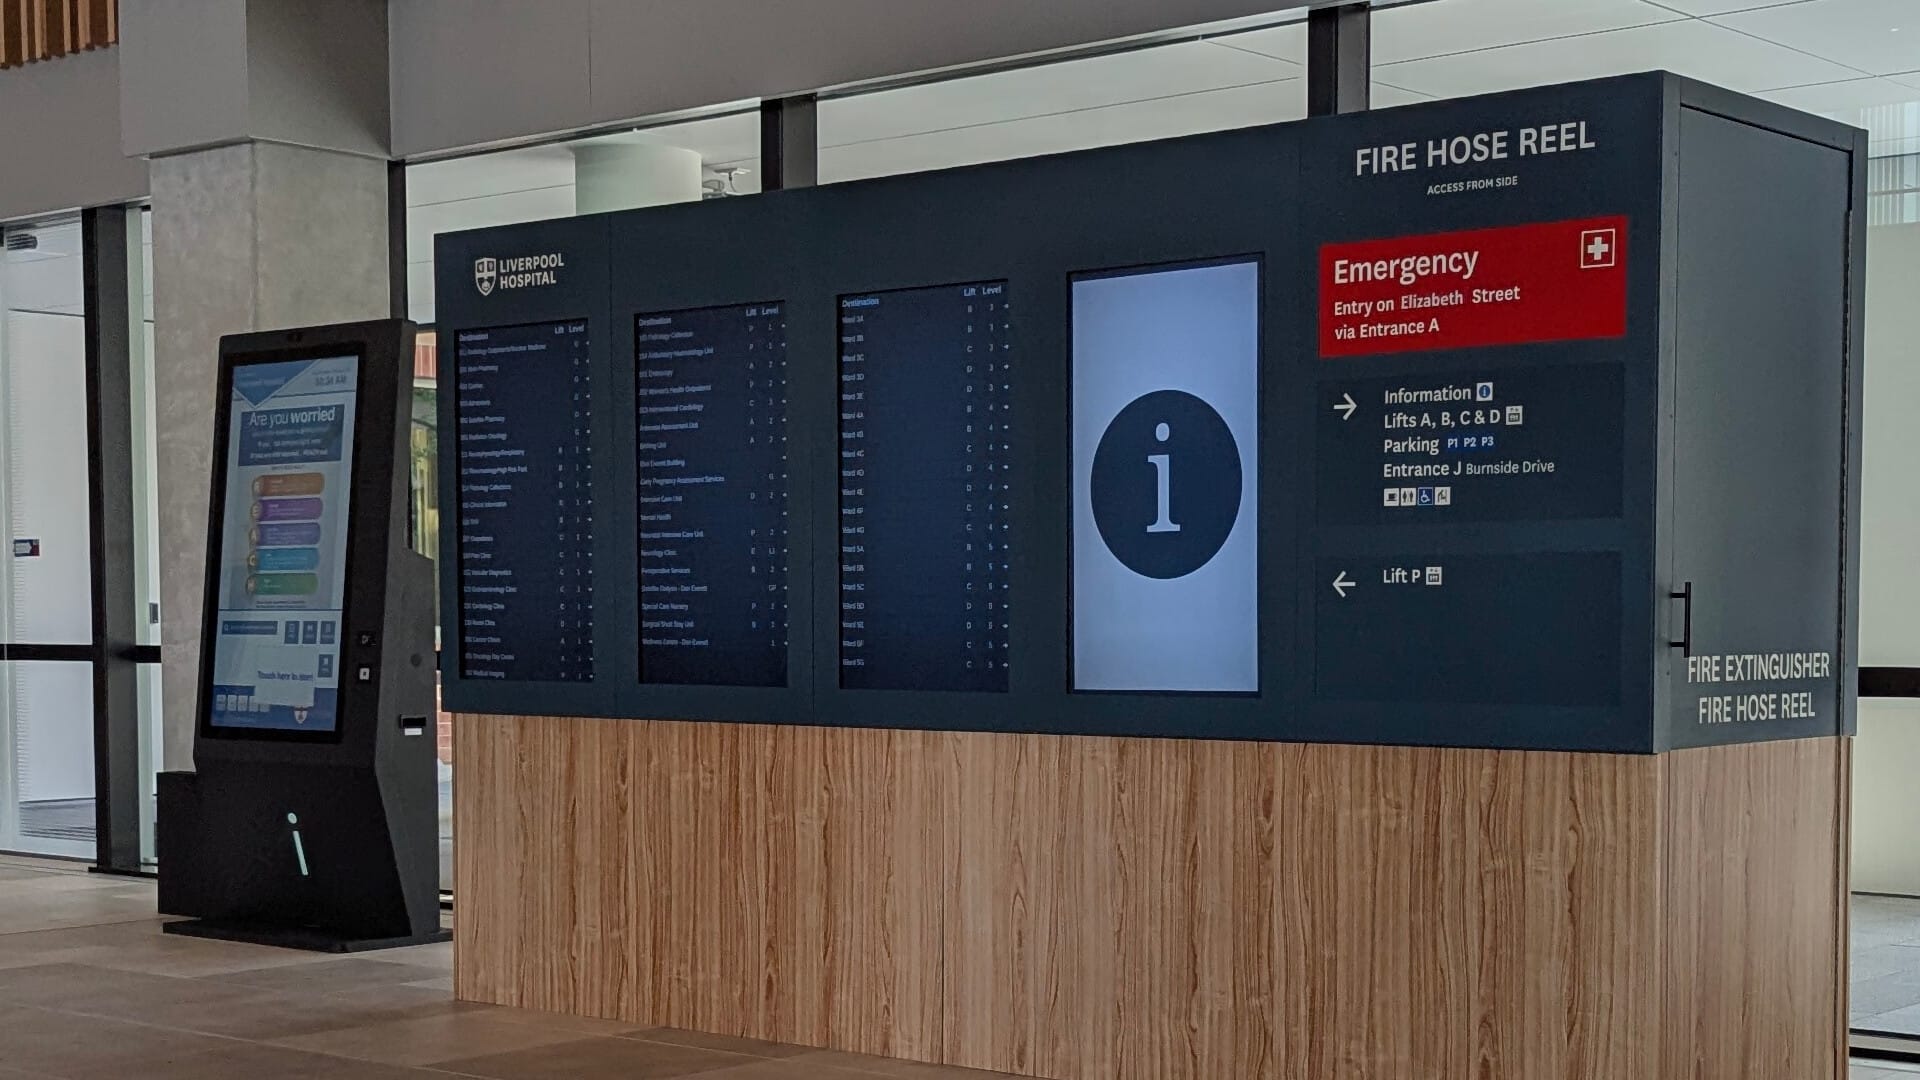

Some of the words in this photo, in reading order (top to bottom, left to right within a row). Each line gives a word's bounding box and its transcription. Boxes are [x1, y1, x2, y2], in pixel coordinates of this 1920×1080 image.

[1355, 143, 1416, 177] FIRE
[1427, 131, 1508, 168] HOSE
[1518, 120, 1596, 157] REEL
[1426, 182, 1464, 196] ACCESS
[1466, 179, 1493, 191] FROM
[1495, 175, 1518, 188] SIDE
[499, 253, 564, 273] LIVERPOOL
[1334, 250, 1479, 286] Emergency
[499, 270, 557, 289] HOSPITAL
[1334, 300, 1373, 317] Entry
[1376, 301, 1394, 313] on
[1400, 291, 1463, 310] Elizabeth
[1471, 285, 1520, 304] Street
[1334, 322, 1355, 340] via
[1359, 320, 1424, 338] Entrance
[1427, 318, 1439, 332] A
[1384, 386, 1471, 405] Information
[249, 411, 268, 427] Are
[269, 413, 288, 428] you
[290, 406, 336, 425] worried
[1383, 413, 1416, 429] Lifts
[1420, 413, 1436, 429] A,
[1441, 412, 1455, 428] B,
[1459, 411, 1470, 426] C
[1473, 410, 1485, 425] &
[1489, 409, 1500, 424] D
[1383, 436, 1439, 455] Parking
[1447, 438, 1458, 450] P1
[1463, 437, 1477, 449] P2
[1481, 436, 1494, 448] P3
[1383, 462, 1450, 478] Entrance
[1453, 461, 1461, 476] J
[1465, 461, 1519, 476] Burnside
[1521, 459, 1555, 474] Drive
[1383, 569, 1408, 584] Lift
[1411, 569, 1420, 584] P
[1687, 655, 1721, 683] FIRE
[1725, 652, 1830, 682] EXTINGUISHER
[1698, 695, 1732, 724] FIRE
[1736, 694, 1777, 722] HOSE
[1780, 692, 1815, 719] REEL
